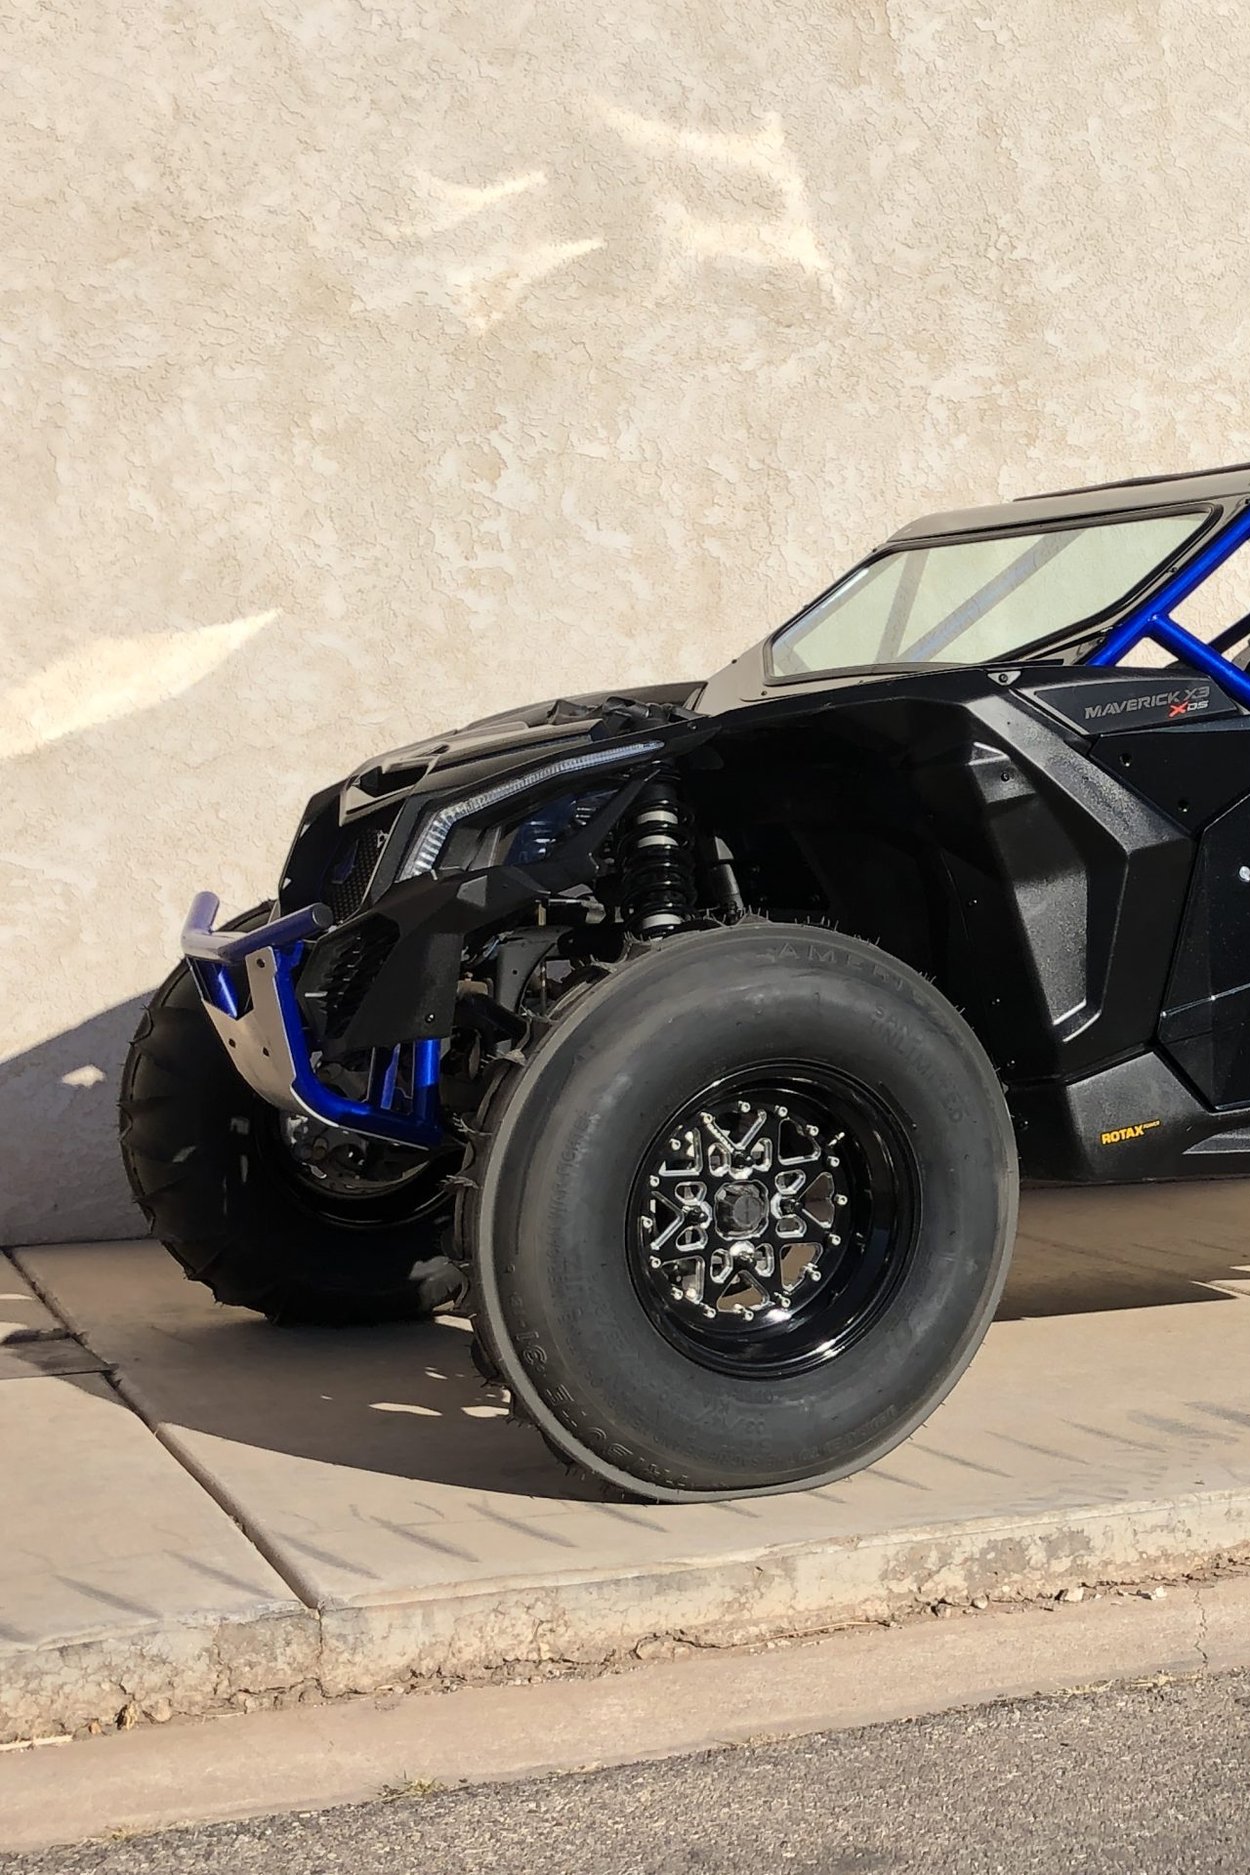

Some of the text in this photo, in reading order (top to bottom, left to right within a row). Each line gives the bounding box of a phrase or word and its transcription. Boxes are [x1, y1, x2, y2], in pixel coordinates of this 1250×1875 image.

[1084, 686, 1210, 719] MAVERICK X3
[1168, 700, 1209, 718] XDS
[1101, 1124, 1145, 1145] ROTAX
